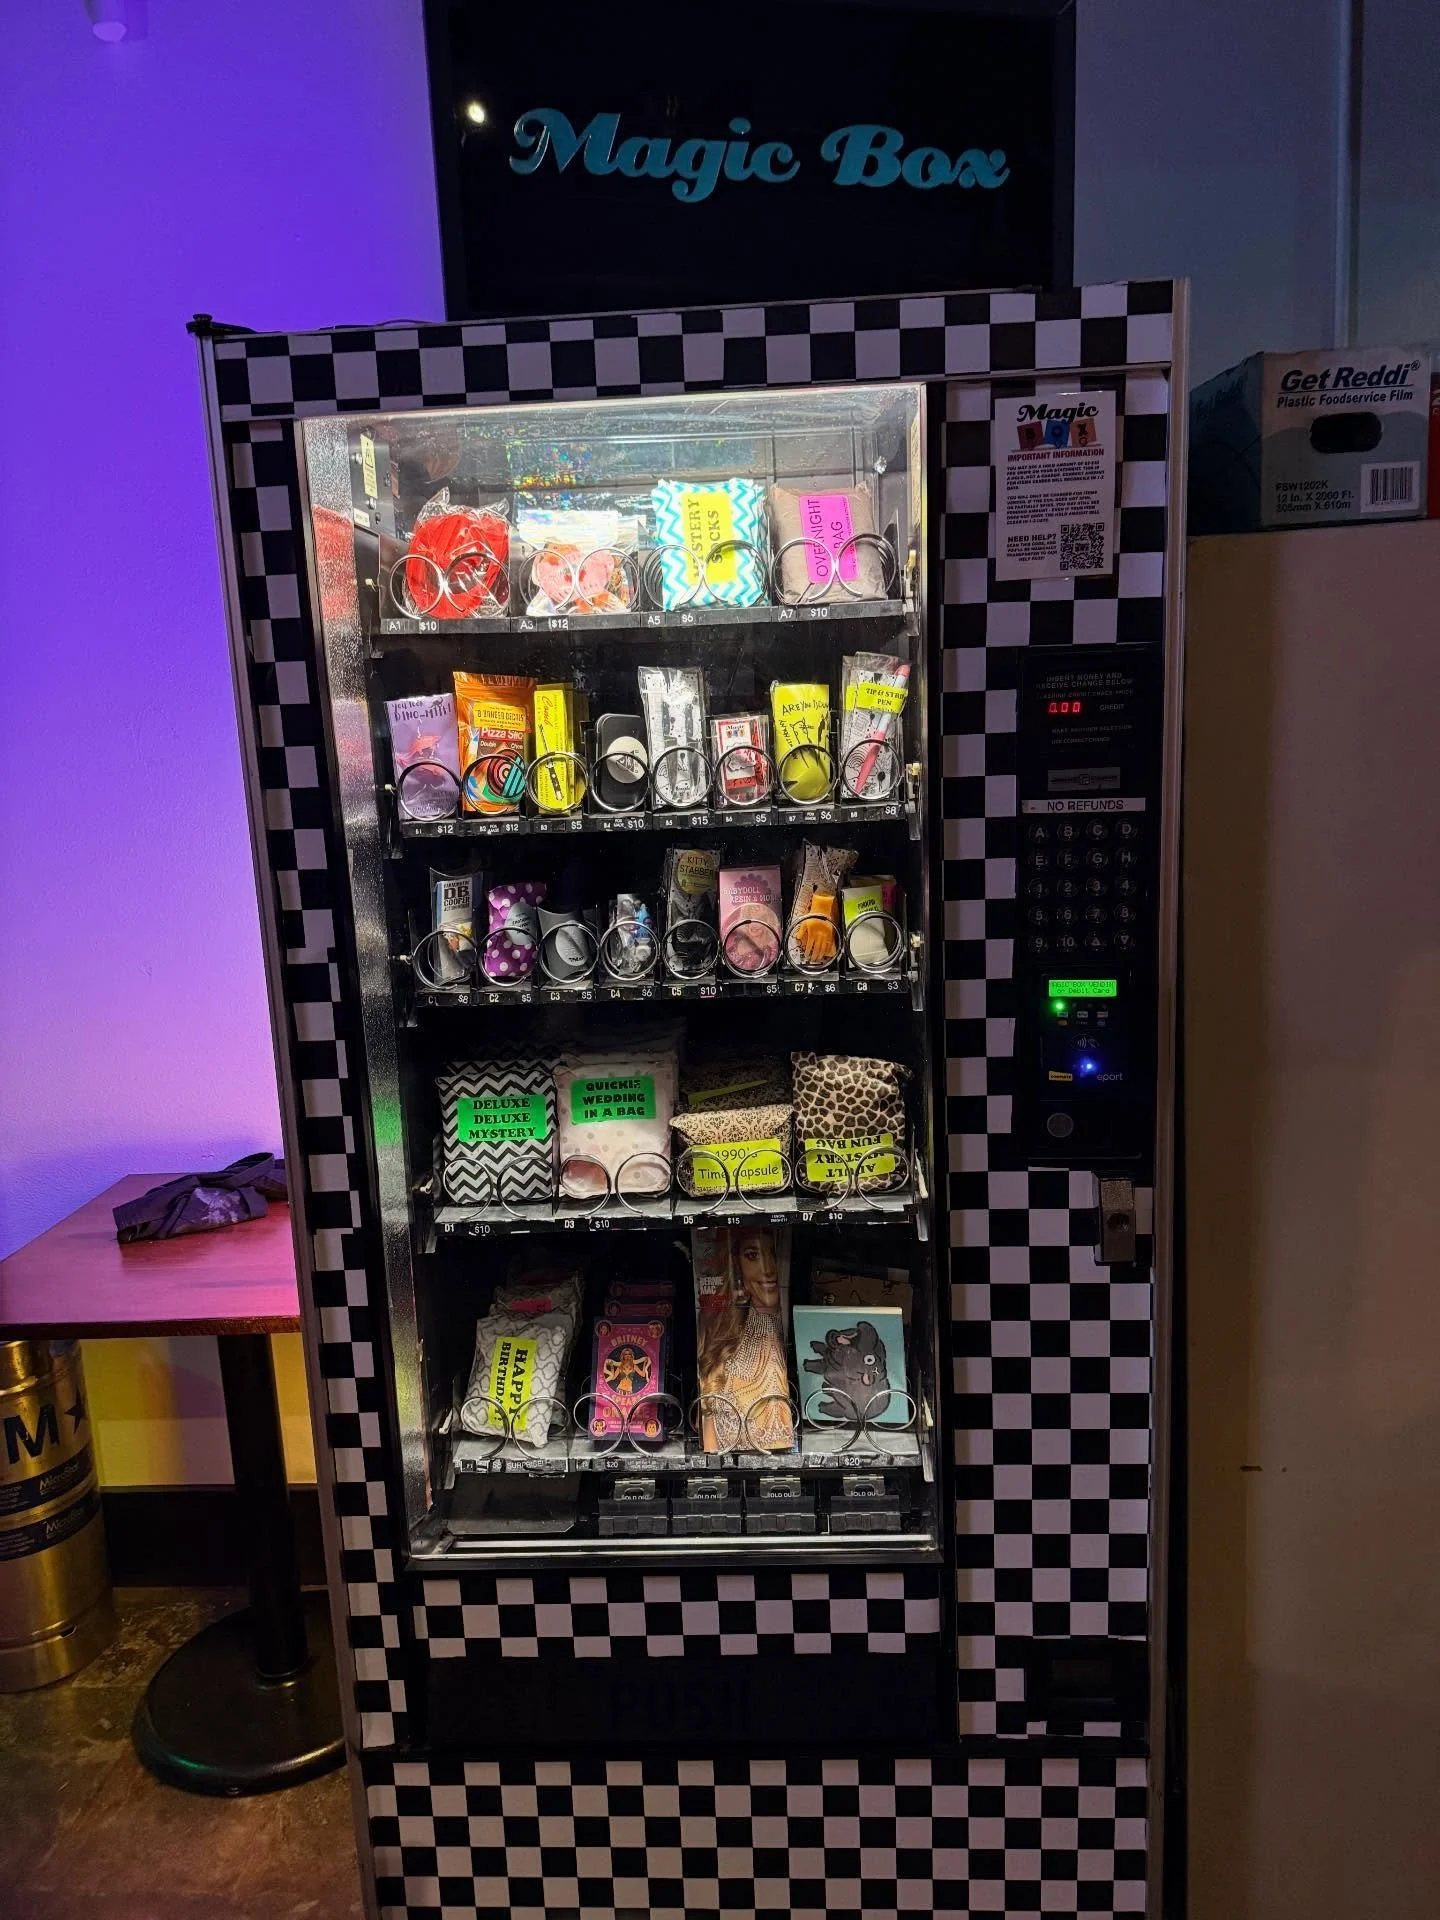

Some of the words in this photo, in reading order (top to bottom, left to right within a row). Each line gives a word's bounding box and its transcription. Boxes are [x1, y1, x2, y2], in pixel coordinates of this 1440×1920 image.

[509, 108, 800, 203] Magic
[820, 123, 1010, 189] Box
[1281, 368, 1332, 392] Get
[1277, 395, 1316, 408] Plastic
[1318, 392, 1387, 406] Foodservice
[1389, 390, 1413, 401] Film
[1017, 402, 1099, 423] Magic
[1007, 451, 1051, 462] IMPORTANT
[1052, 448, 1104, 459] INFORMATION
[1007, 535, 1029, 543] NEED
[647, 615, 661, 625] A5
[681, 613, 694, 622] $6
[780, 609, 793, 620] A7
[810, 608, 828, 618] $10
[420, 621, 437, 632] $10
[520, 619, 534, 630] A3
[482, 727, 506, 738] Pizza
[1047, 802, 1064, 811] NO
[1068, 800, 1124, 810] REFUNDS
[821, 811, 832, 820] $6
[885, 807, 897, 815] $8
[628, 819, 644, 829] $10
[692, 816, 708, 825] $15
[756, 815, 767, 823] $5
[437, 825, 453, 834] $12
[506, 824, 519, 832] $12
[571, 820, 583, 830] $5
[688, 856, 708, 866] KITTY
[444, 885, 469, 899] DB
[444, 897, 470, 907] COOPER
[672, 987, 682, 996] C5
[700, 987, 717, 995] $10
[766, 985, 777, 994] $5
[795, 983, 804, 992] C7
[825, 984, 836, 992] $6
[857, 982, 868, 991] C8
[887, 982, 898, 990] $3
[581, 991, 592, 999] $5
[610, 990, 621, 998] C4
[642, 988, 652, 997] $6
[489, 994, 499, 1003] C2
[522, 994, 532, 1002] $5
[585, 1080, 641, 1092] QUICKIE
[473, 1098, 531, 1110] DELUXE
[583, 1093, 646, 1105] WEDDING
[584, 1108, 599, 1119] IN
[602, 1108, 613, 1117] A
[617, 1106, 645, 1116] BAG
[474, 1113, 531, 1124] DELUXE
[468, 1127, 536, 1139] MYSTERY
[816, 1139, 846, 1149] BAG
[851, 1136, 882, 1147] FUN
[698, 1168, 726, 1180] Time
[733, 1164, 779, 1180] Capsule
[683, 1216, 694, 1225] D5
[727, 1217, 740, 1225] $15
[803, 1213, 813, 1221] D7
[828, 1213, 843, 1221] $10
[444, 1224, 455, 1232] D1
[474, 1225, 490, 1234] $10
[564, 1220, 575, 1229] D3
[595, 1220, 610, 1228] $10
[701, 1285, 717, 1296] MAC
[611, 1334, 649, 1347] BRITNEY
[4, 1403, 60, 1465] M
[845, 1458, 860, 1466] $20
